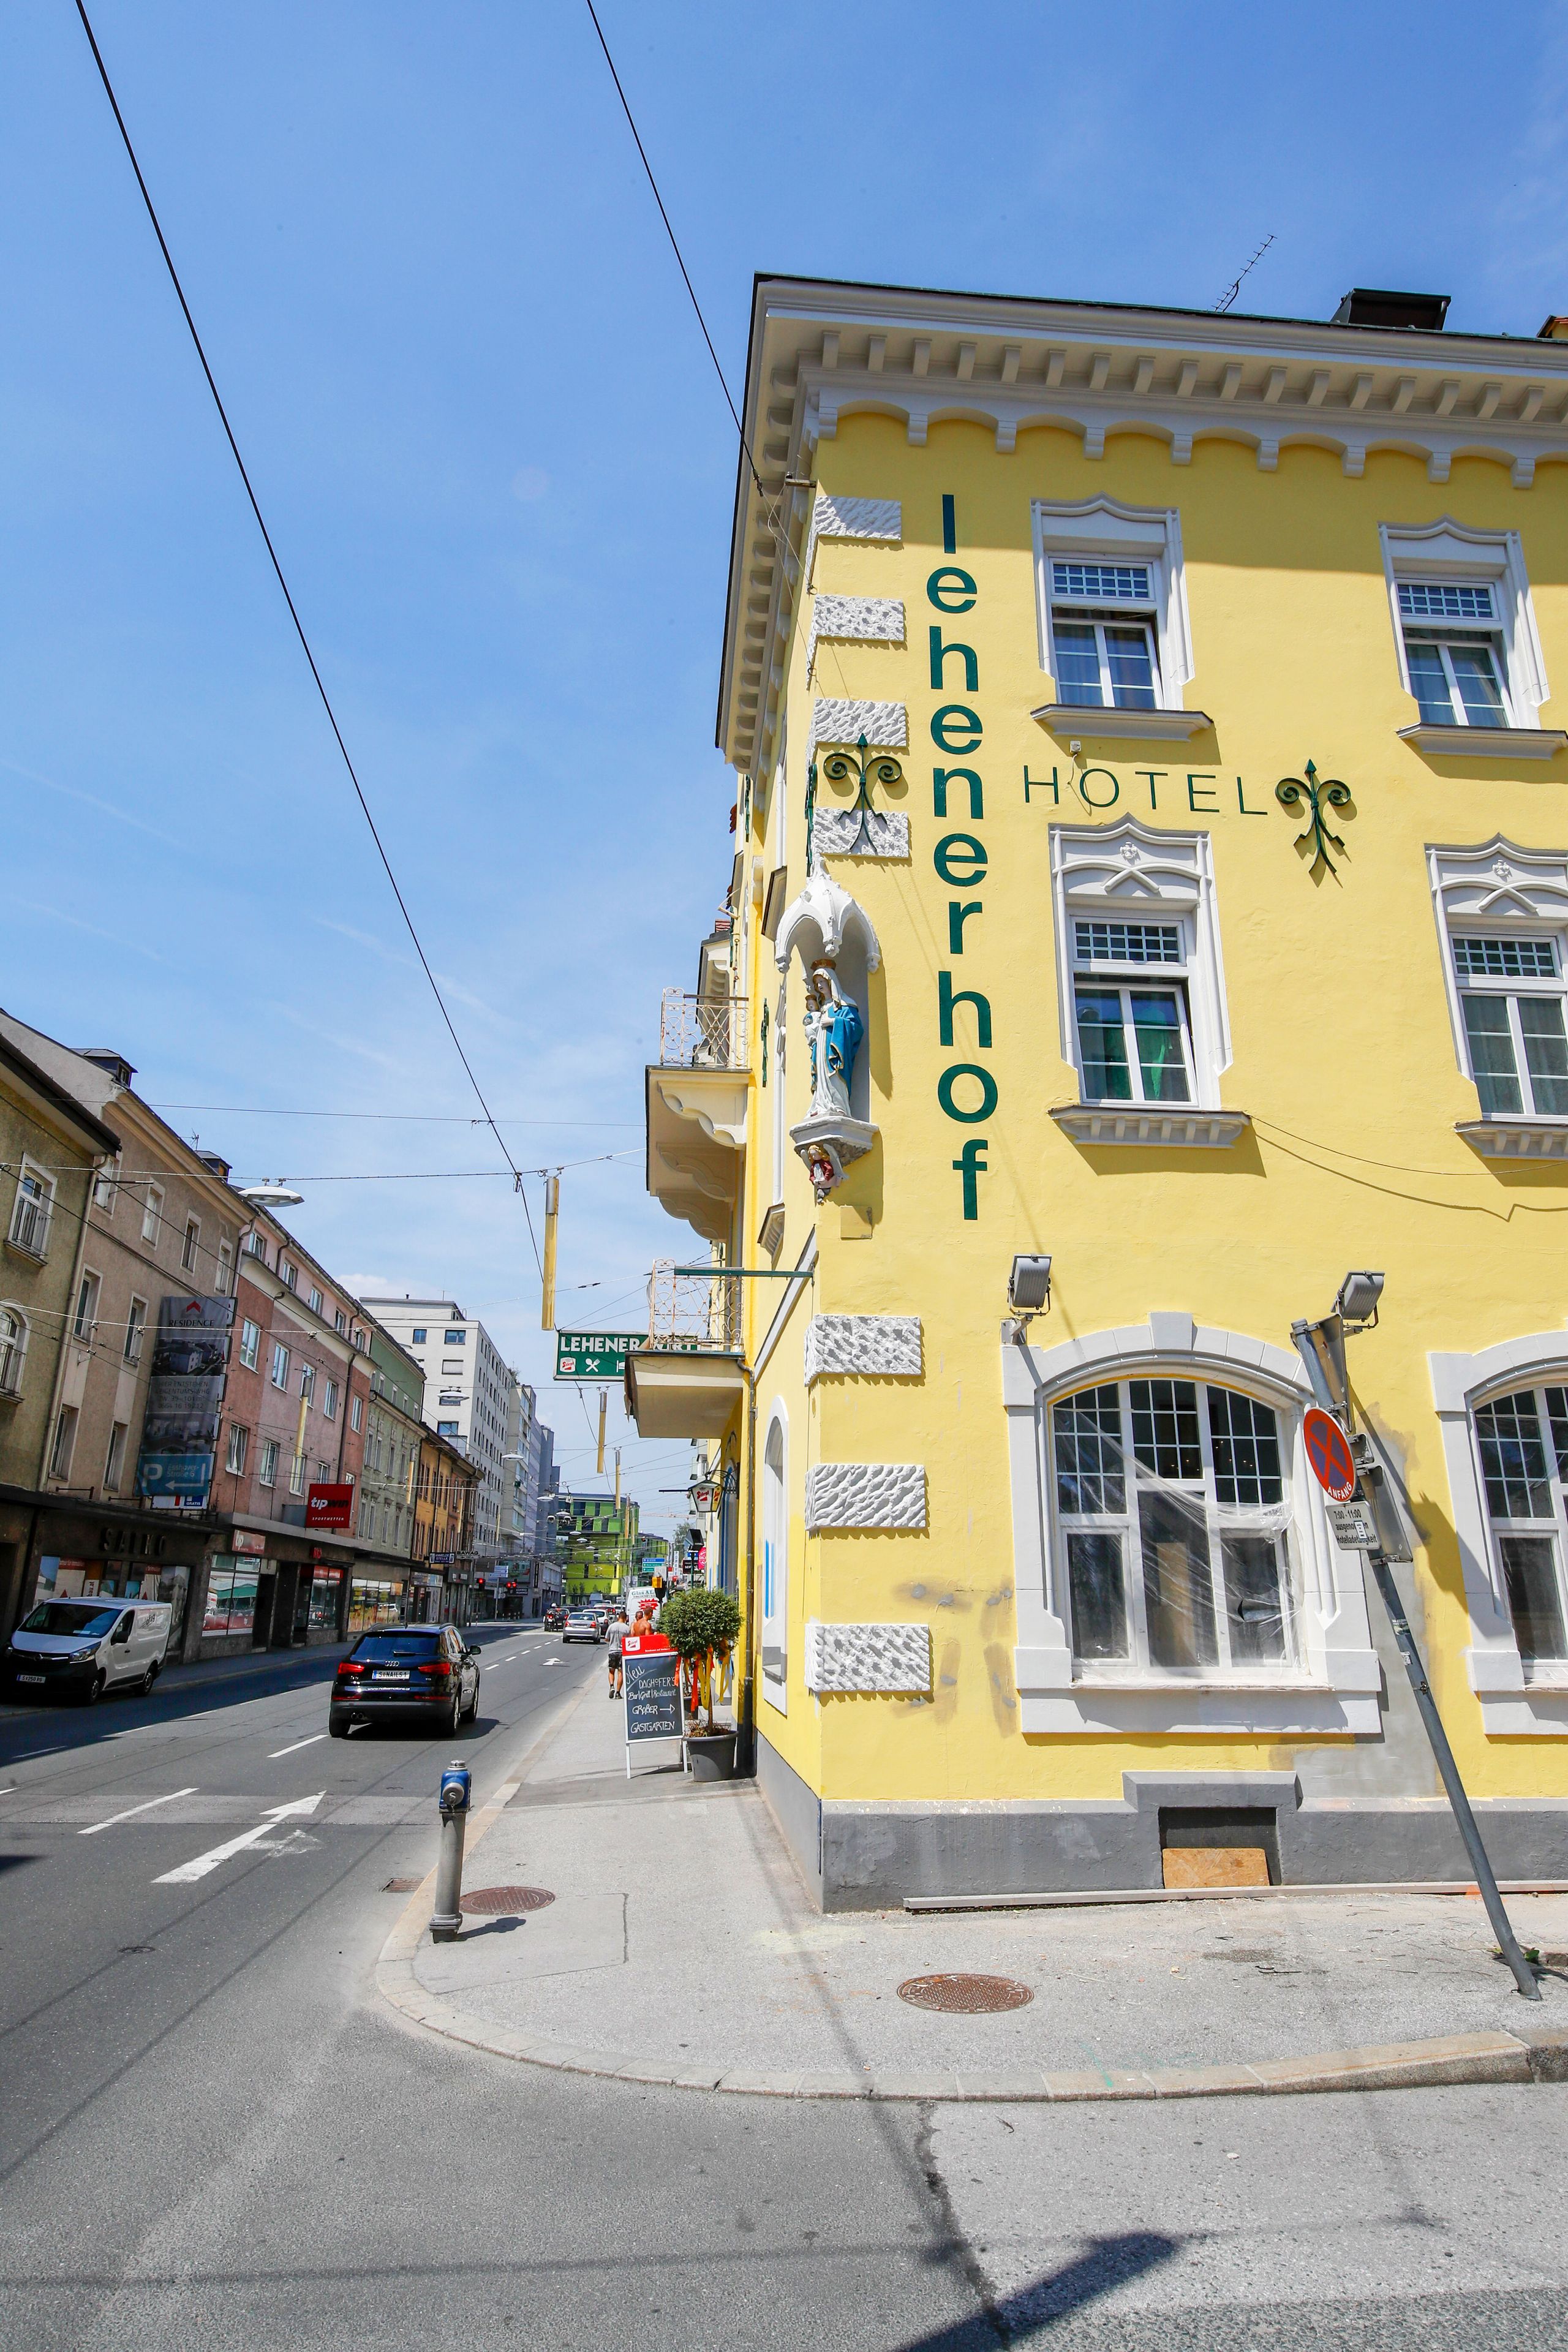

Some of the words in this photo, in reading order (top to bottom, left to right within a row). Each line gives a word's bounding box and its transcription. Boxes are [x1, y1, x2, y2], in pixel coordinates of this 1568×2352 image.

[1023, 765, 1268, 815] HOTEL
[927, 494, 998, 1221] lehenerhof
[560, 1336, 640, 1352] LEHENER
[1327, 1482, 1352, 1499] ANFANG
[1333, 1510, 1345, 1519] 7:00
[1348, 1509, 1362, 1519] 11:00
[626, 1665, 645, 1684] Neu
[630, 1721, 676, 1734] GASTGARTEN
